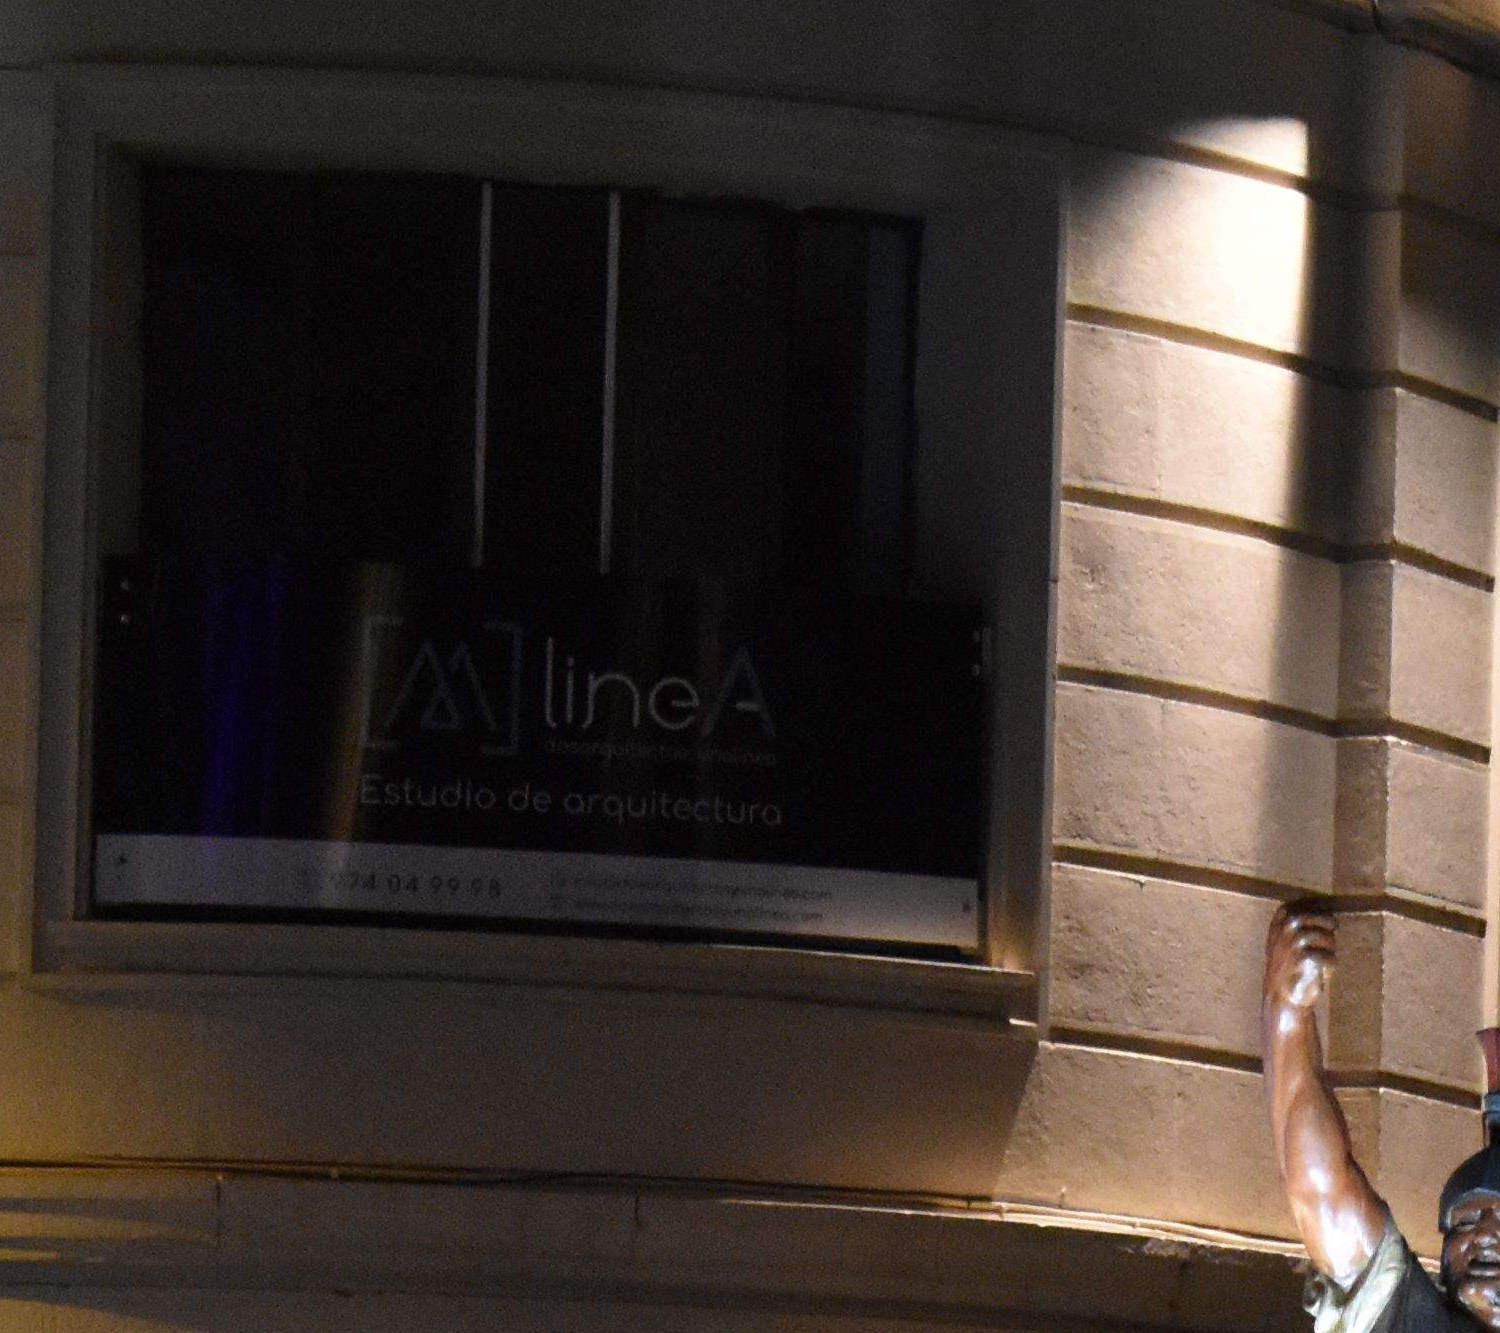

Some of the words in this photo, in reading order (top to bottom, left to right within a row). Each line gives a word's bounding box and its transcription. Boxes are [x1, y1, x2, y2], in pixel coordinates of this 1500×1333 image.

[359, 773, 497, 812] Estudio
[507, 783, 552, 814] de
[561, 790, 783, 828] arquitectura
